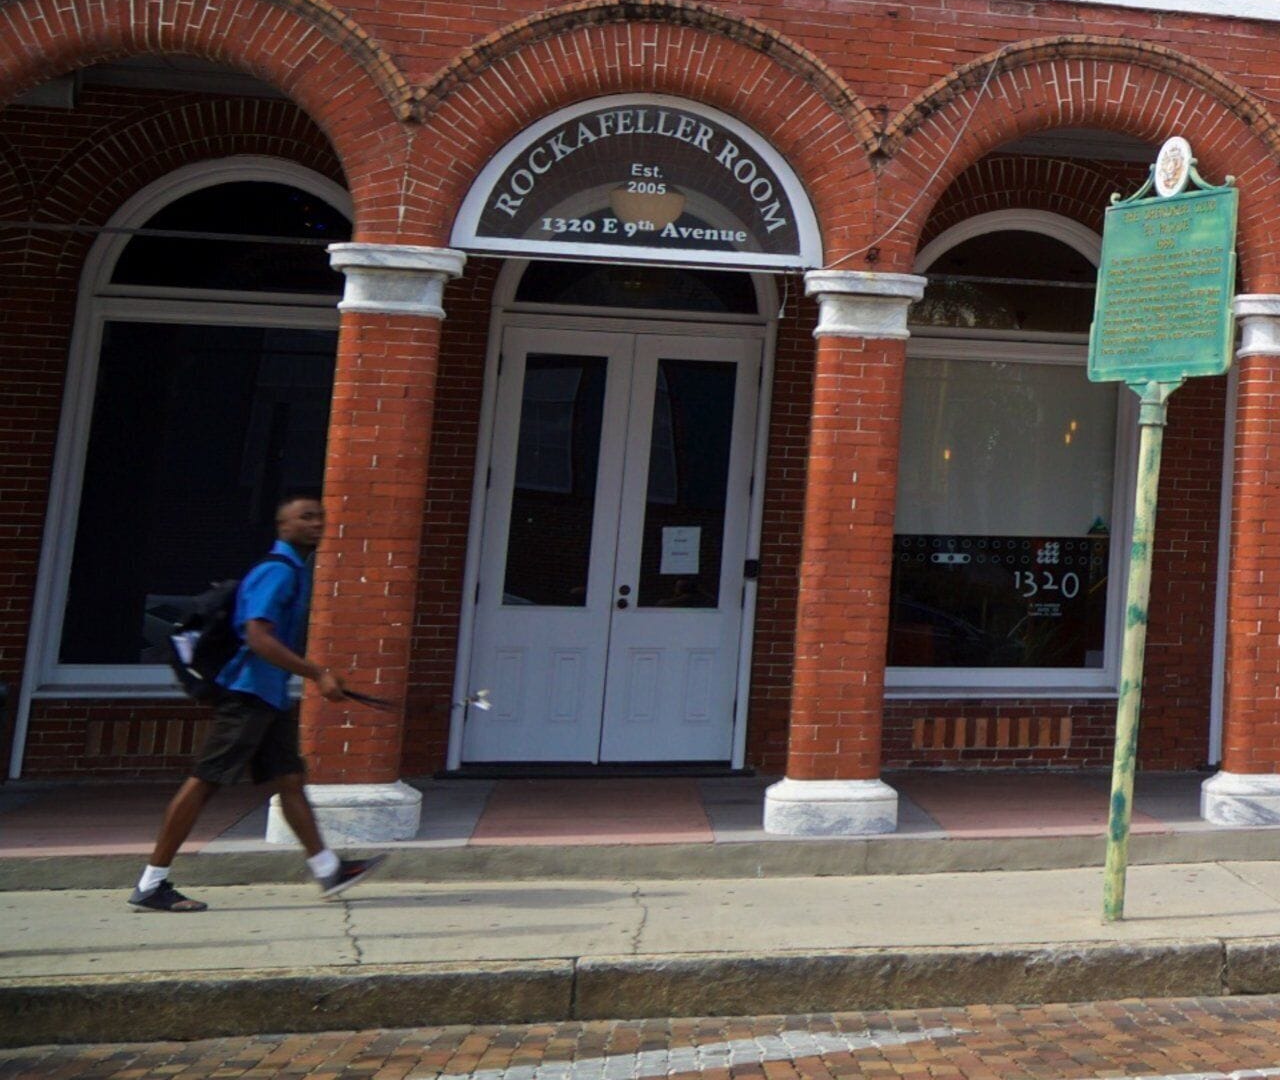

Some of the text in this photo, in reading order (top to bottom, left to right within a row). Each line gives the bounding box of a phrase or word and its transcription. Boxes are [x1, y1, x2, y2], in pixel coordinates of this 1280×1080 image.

[494, 109, 787, 235] ROCKAFELLER ROOM
[631, 163, 663, 179] Est.
[627, 181, 666, 196] 2005
[541, 217, 747, 243] 1320 E 9th Avenue
[1014, 571, 1080, 599] 1320
